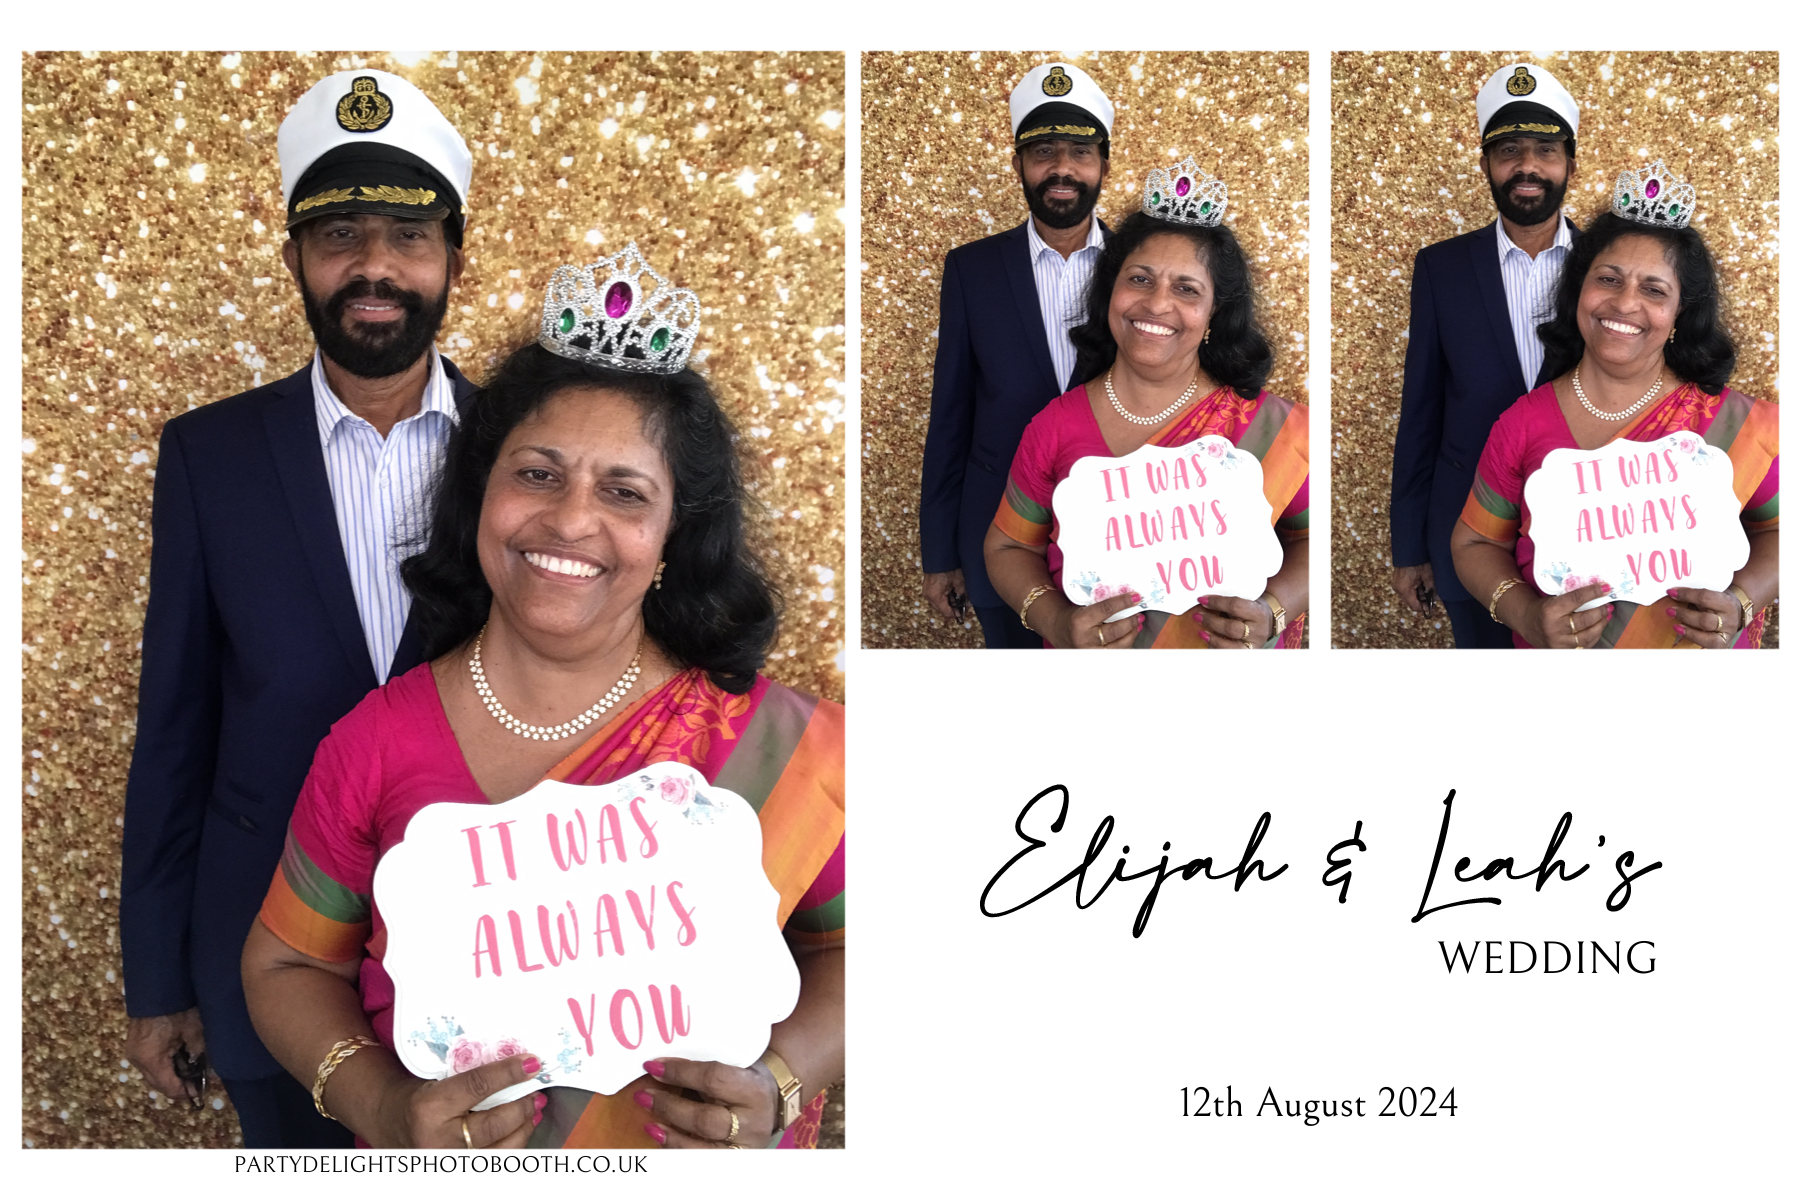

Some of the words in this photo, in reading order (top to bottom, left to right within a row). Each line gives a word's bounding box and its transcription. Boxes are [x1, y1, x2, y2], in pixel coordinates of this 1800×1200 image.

[1099, 465, 1131, 503] IT
[1146, 453, 1208, 494] WAS
[1572, 458, 1603, 495] IT
[1618, 448, 1679, 488] WAS
[1105, 499, 1228, 552] ALWAYS
[1576, 494, 1697, 543] ALWAYS
[1156, 555, 1224, 595] YOU
[1626, 548, 1692, 586] YOU
[460, 819, 518, 888] IT
[546, 796, 659, 872] WAS
[472, 880, 697, 979] ALWAYS
[567, 984, 691, 1057] YOU
